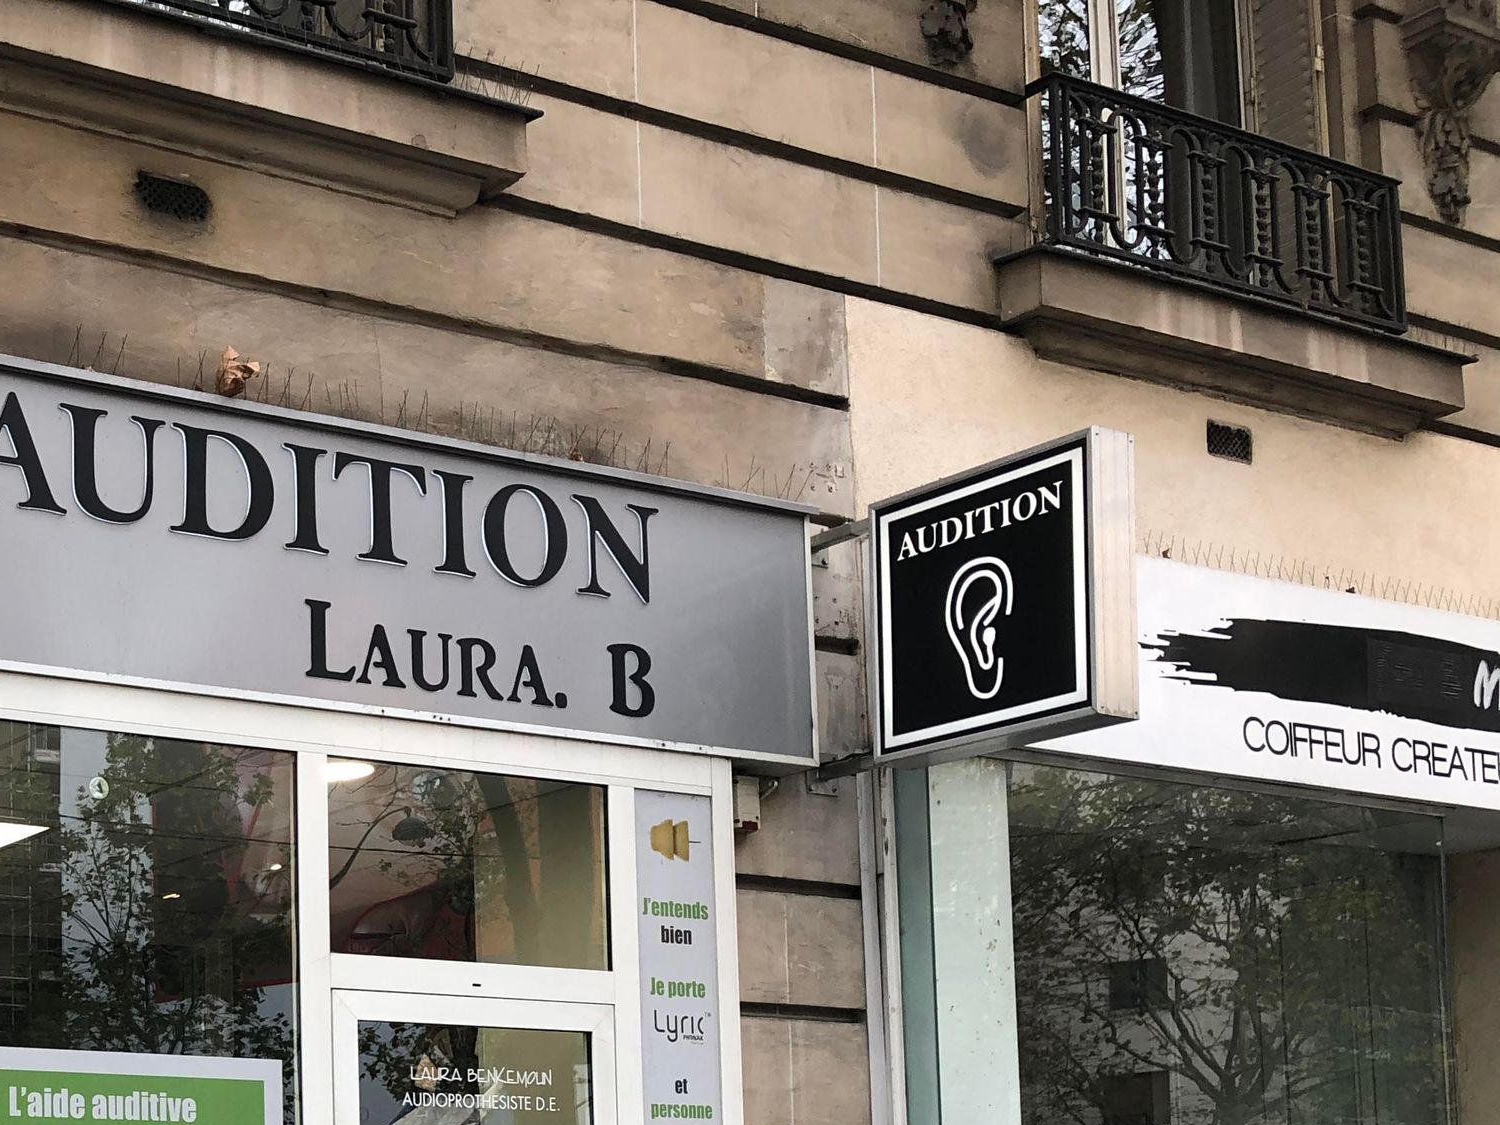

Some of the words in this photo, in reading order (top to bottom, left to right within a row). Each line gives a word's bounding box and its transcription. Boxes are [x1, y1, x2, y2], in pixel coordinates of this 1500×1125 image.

[896, 479, 1064, 562] AUDITION
[606, 643, 656, 718] B
[1243, 715, 1381, 769] COIFFEUR
[1391, 737, 1500, 785] CREATE
[642, 897, 709, 920] J'entends
[661, 925, 692, 945] bien
[668, 978, 706, 998] porte
[654, 1009, 704, 1042] Lyric
[410, 1066, 463, 1082] LAURA
[675, 1078, 688, 1094] et
[8, 1086, 86, 1119] L'aide
[91, 1091, 197, 1123] auditive
[402, 1091, 531, 1112] AUDIOPROTHESISTE
[535, 1096, 560, 1111] D.E.
[650, 1103, 713, 1119] personne
